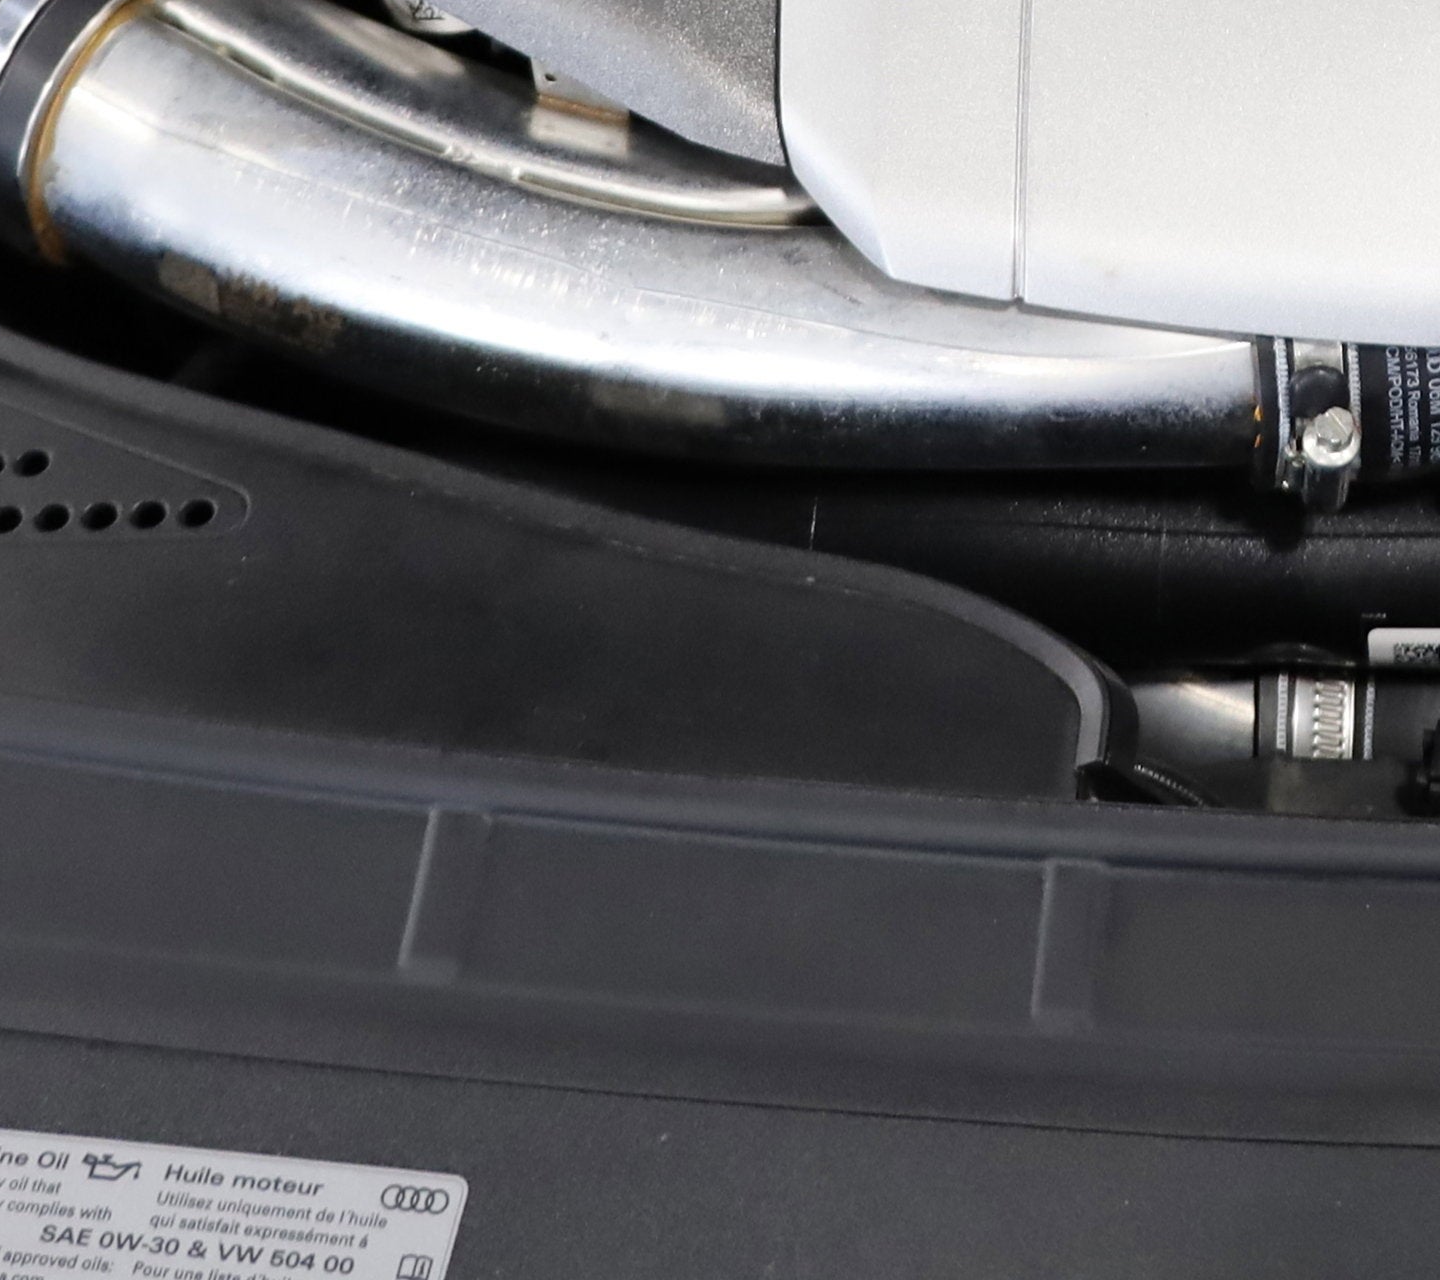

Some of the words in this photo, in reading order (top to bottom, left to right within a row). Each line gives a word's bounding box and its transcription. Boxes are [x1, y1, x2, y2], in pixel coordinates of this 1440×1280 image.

[37, 1150, 71, 1171] Oil
[10, 1175, 31, 1191] oil
[32, 1178, 62, 1195] that
[163, 1163, 225, 1188] Huile
[232, 1172, 324, 1197] moteur
[7, 1194, 76, 1220] complies
[79, 1205, 113, 1221] with
[157, 1191, 214, 1211] Utilisez
[217, 1199, 311, 1222] uniquement
[315, 1208, 336, 1225] de
[149, 1213, 174, 1232] qui
[178, 1216, 240, 1237] satisfait
[39, 1223, 94, 1247] SAE
[98, 1230, 180, 1256] 0W-30
[187, 1239, 208, 1259] &
[219, 1241, 264, 1265] VW
[269, 1248, 316, 1271] 504
[323, 1255, 356, 1275] 00
[2, 1250, 79, 1270] approved
[81, 1256, 115, 1274] oils:
[132, 1260, 170, 1279] Pour
